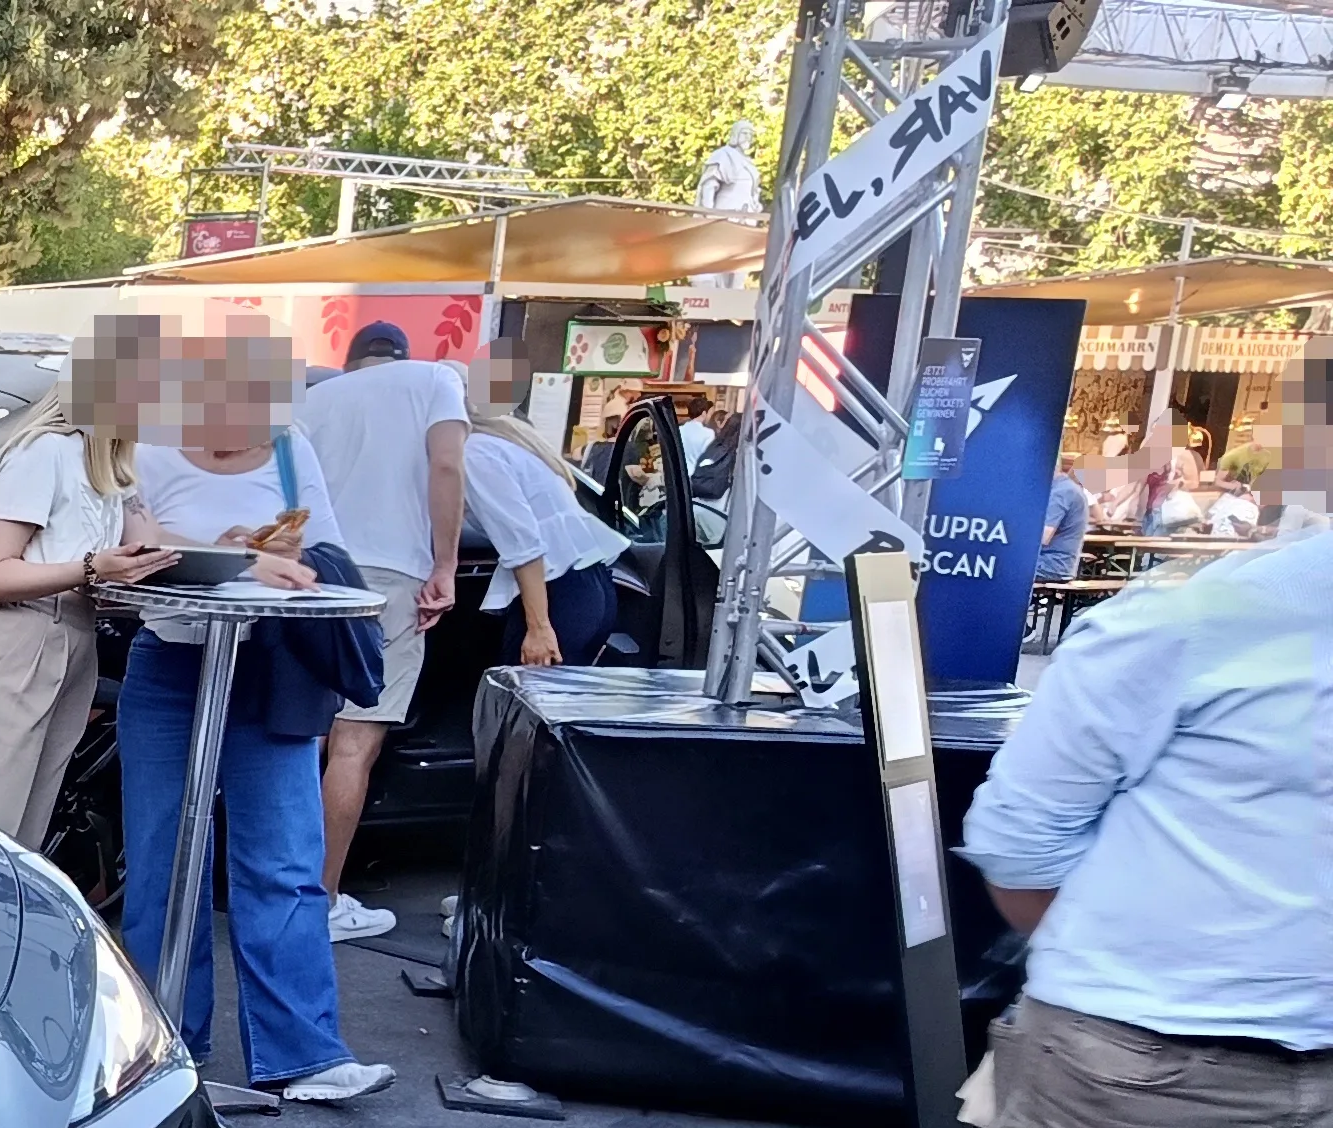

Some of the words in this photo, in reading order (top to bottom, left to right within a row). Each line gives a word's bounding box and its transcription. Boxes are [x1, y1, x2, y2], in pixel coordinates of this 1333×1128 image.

[683, 297, 710, 309] PIZZA
[1200, 342, 1235, 356] DEMEL
[923, 365, 946, 376] JETZT
[921, 376, 967, 387] PROBEFAHRT
[919, 387, 950, 397] BUCHEN
[918, 398, 935, 408] UND
[936, 398, 965, 408] TICKETS
[925, 513, 1009, 545] UPRA
[920, 551, 997, 580] SCAN
